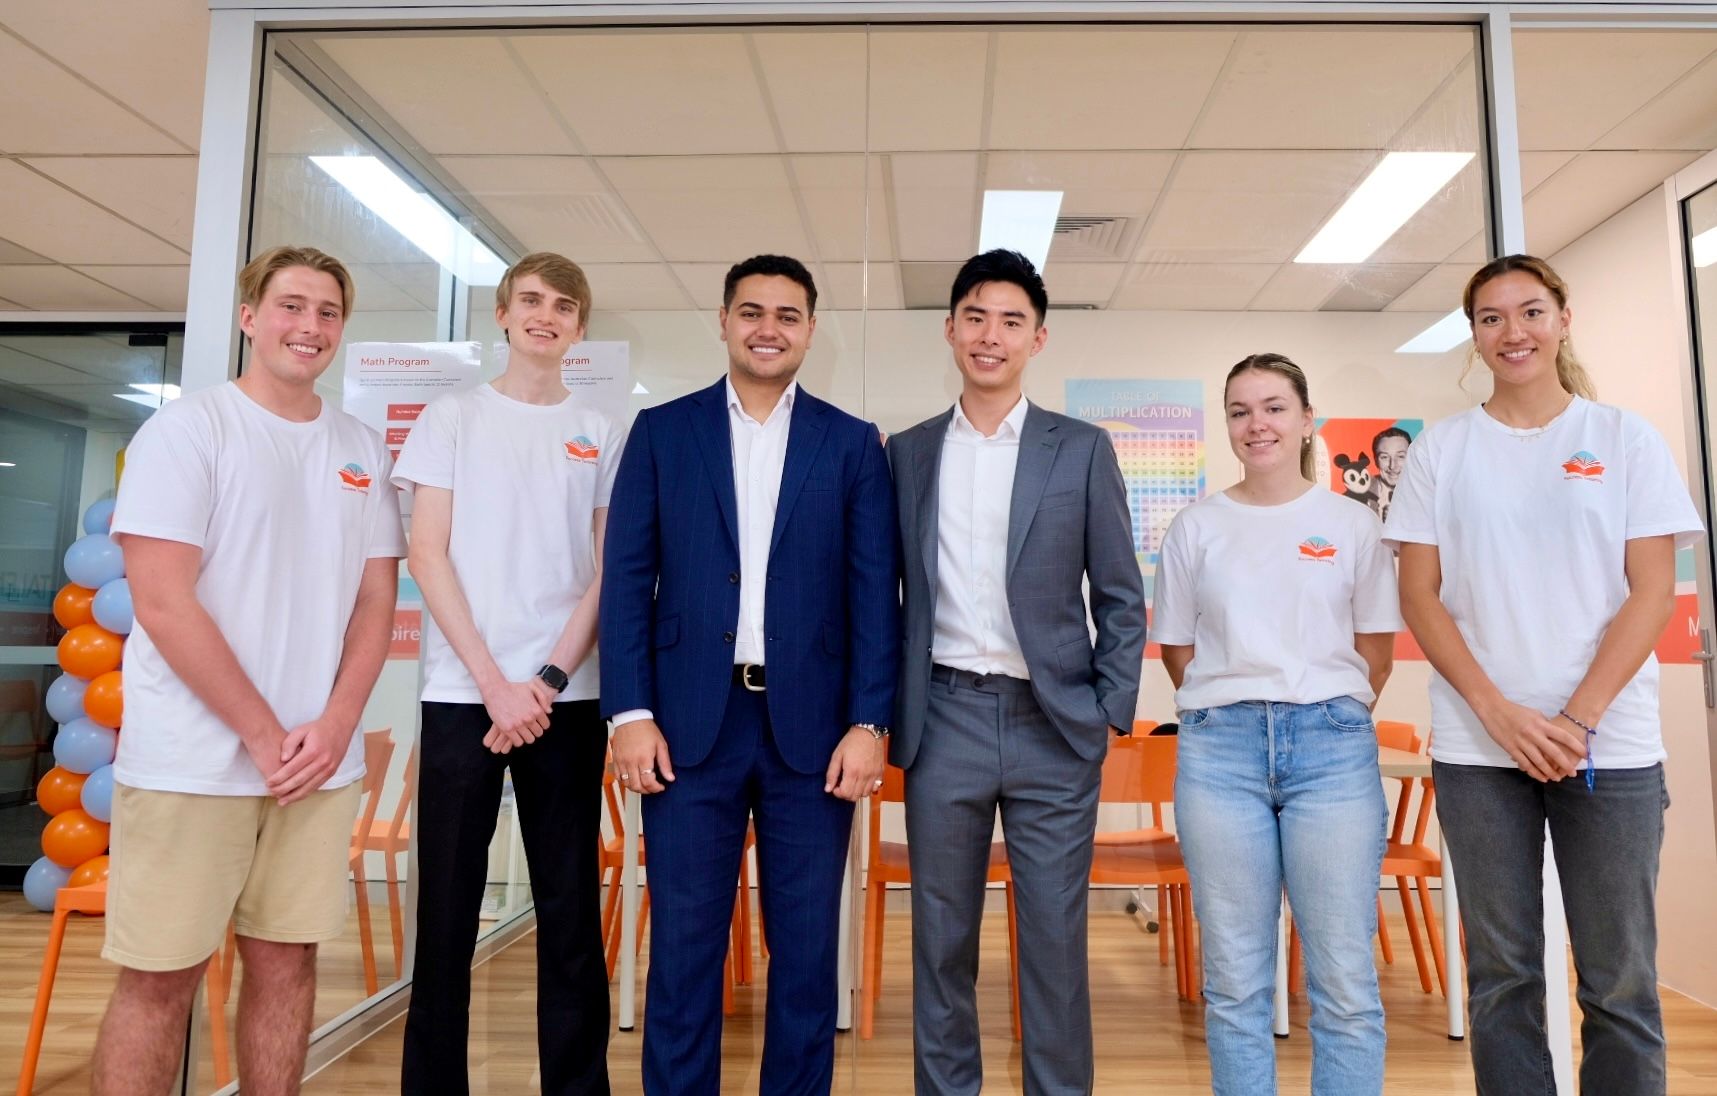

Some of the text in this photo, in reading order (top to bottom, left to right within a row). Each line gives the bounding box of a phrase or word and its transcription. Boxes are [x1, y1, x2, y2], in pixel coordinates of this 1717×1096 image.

[360, 357, 430, 368] Math Program
[560, 357, 590, 367] ogram
[1079, 406, 1192, 418] MULTIPLICATION
[391, 625, 421, 641] ire
